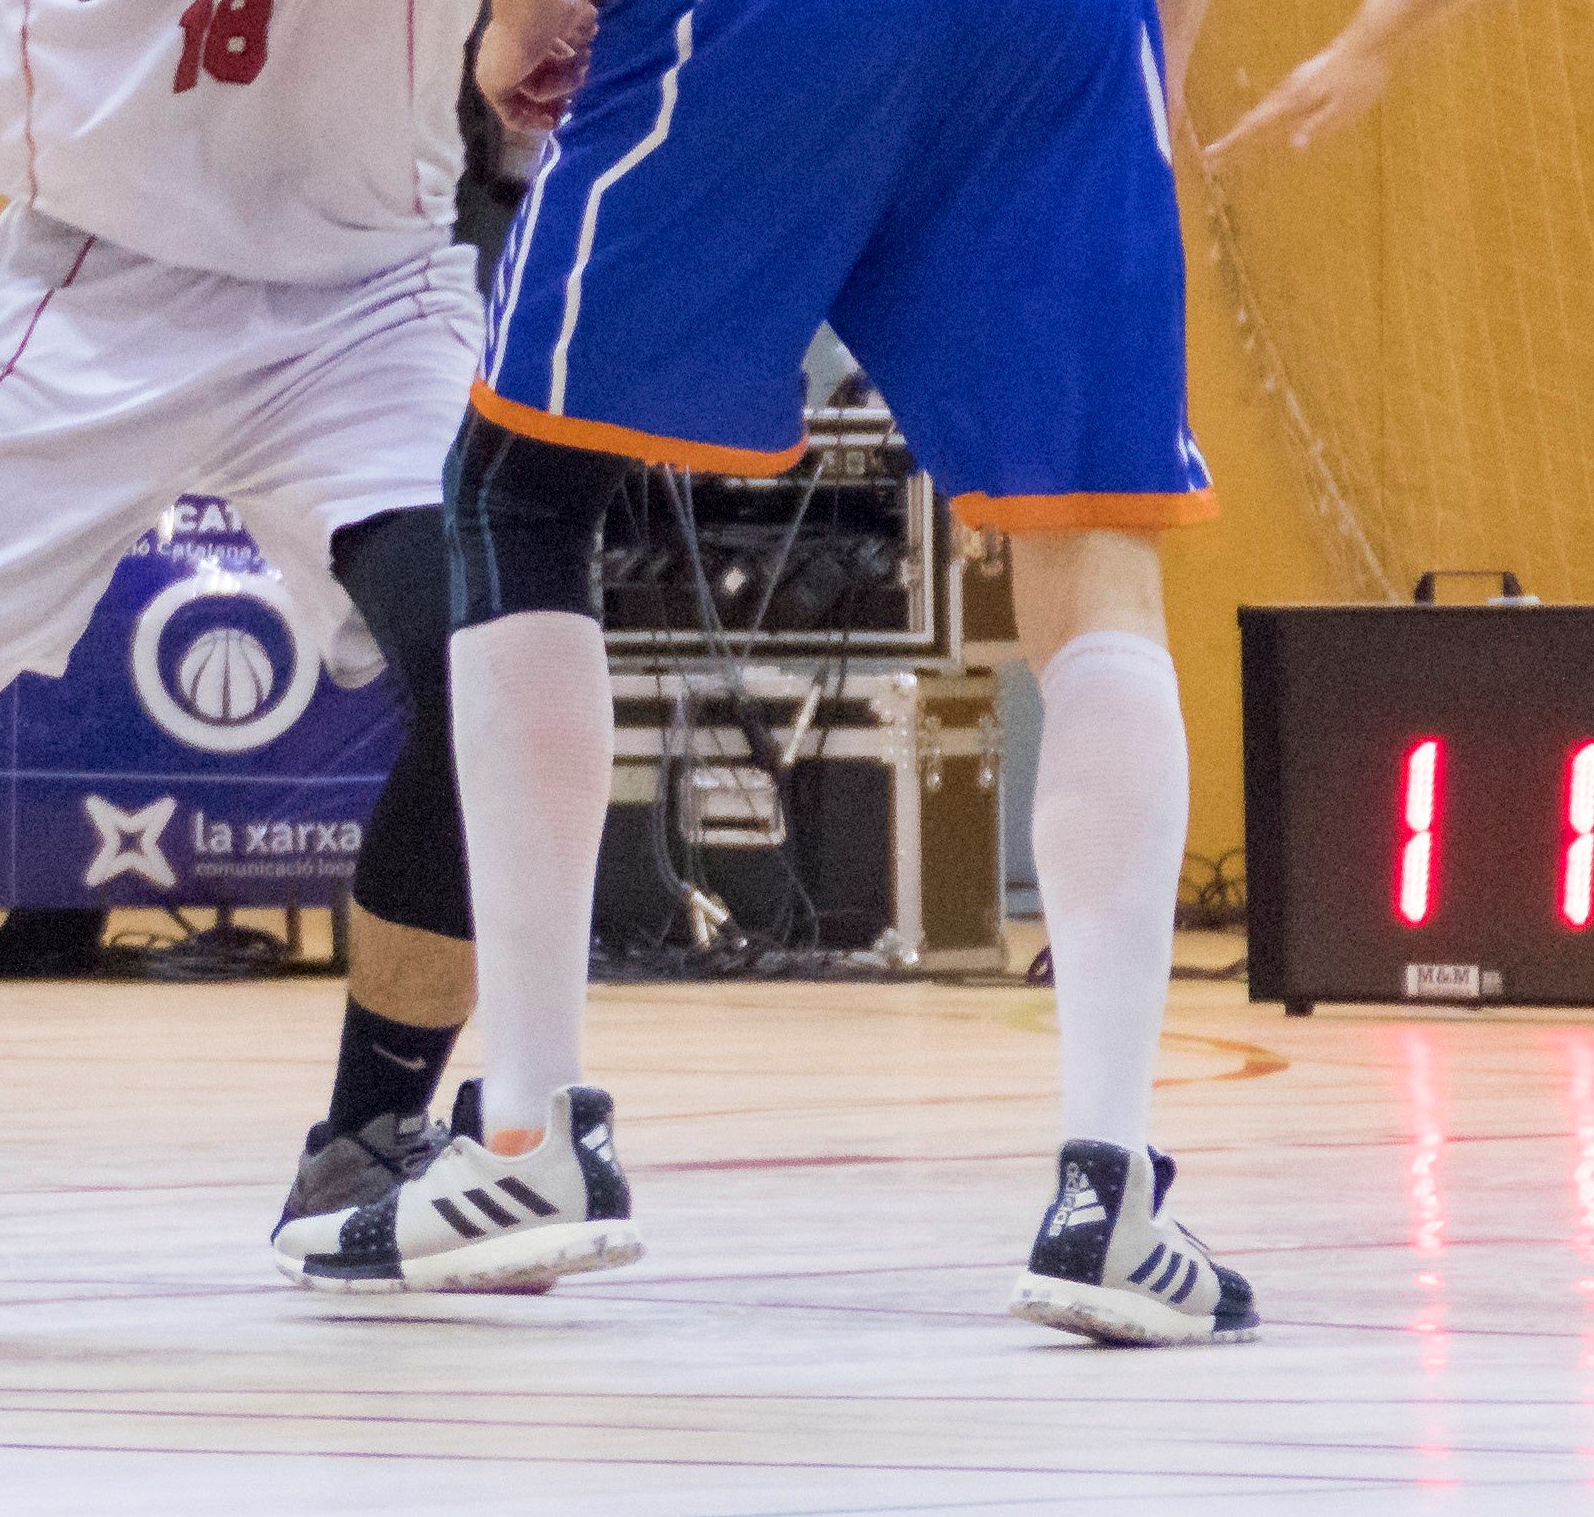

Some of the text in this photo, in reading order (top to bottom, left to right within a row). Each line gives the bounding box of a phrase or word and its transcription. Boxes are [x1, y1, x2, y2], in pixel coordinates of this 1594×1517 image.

[174, 504, 243, 532] CAT
[193, 810, 364, 854] la xarxa
[319, 858, 356, 876] loca
